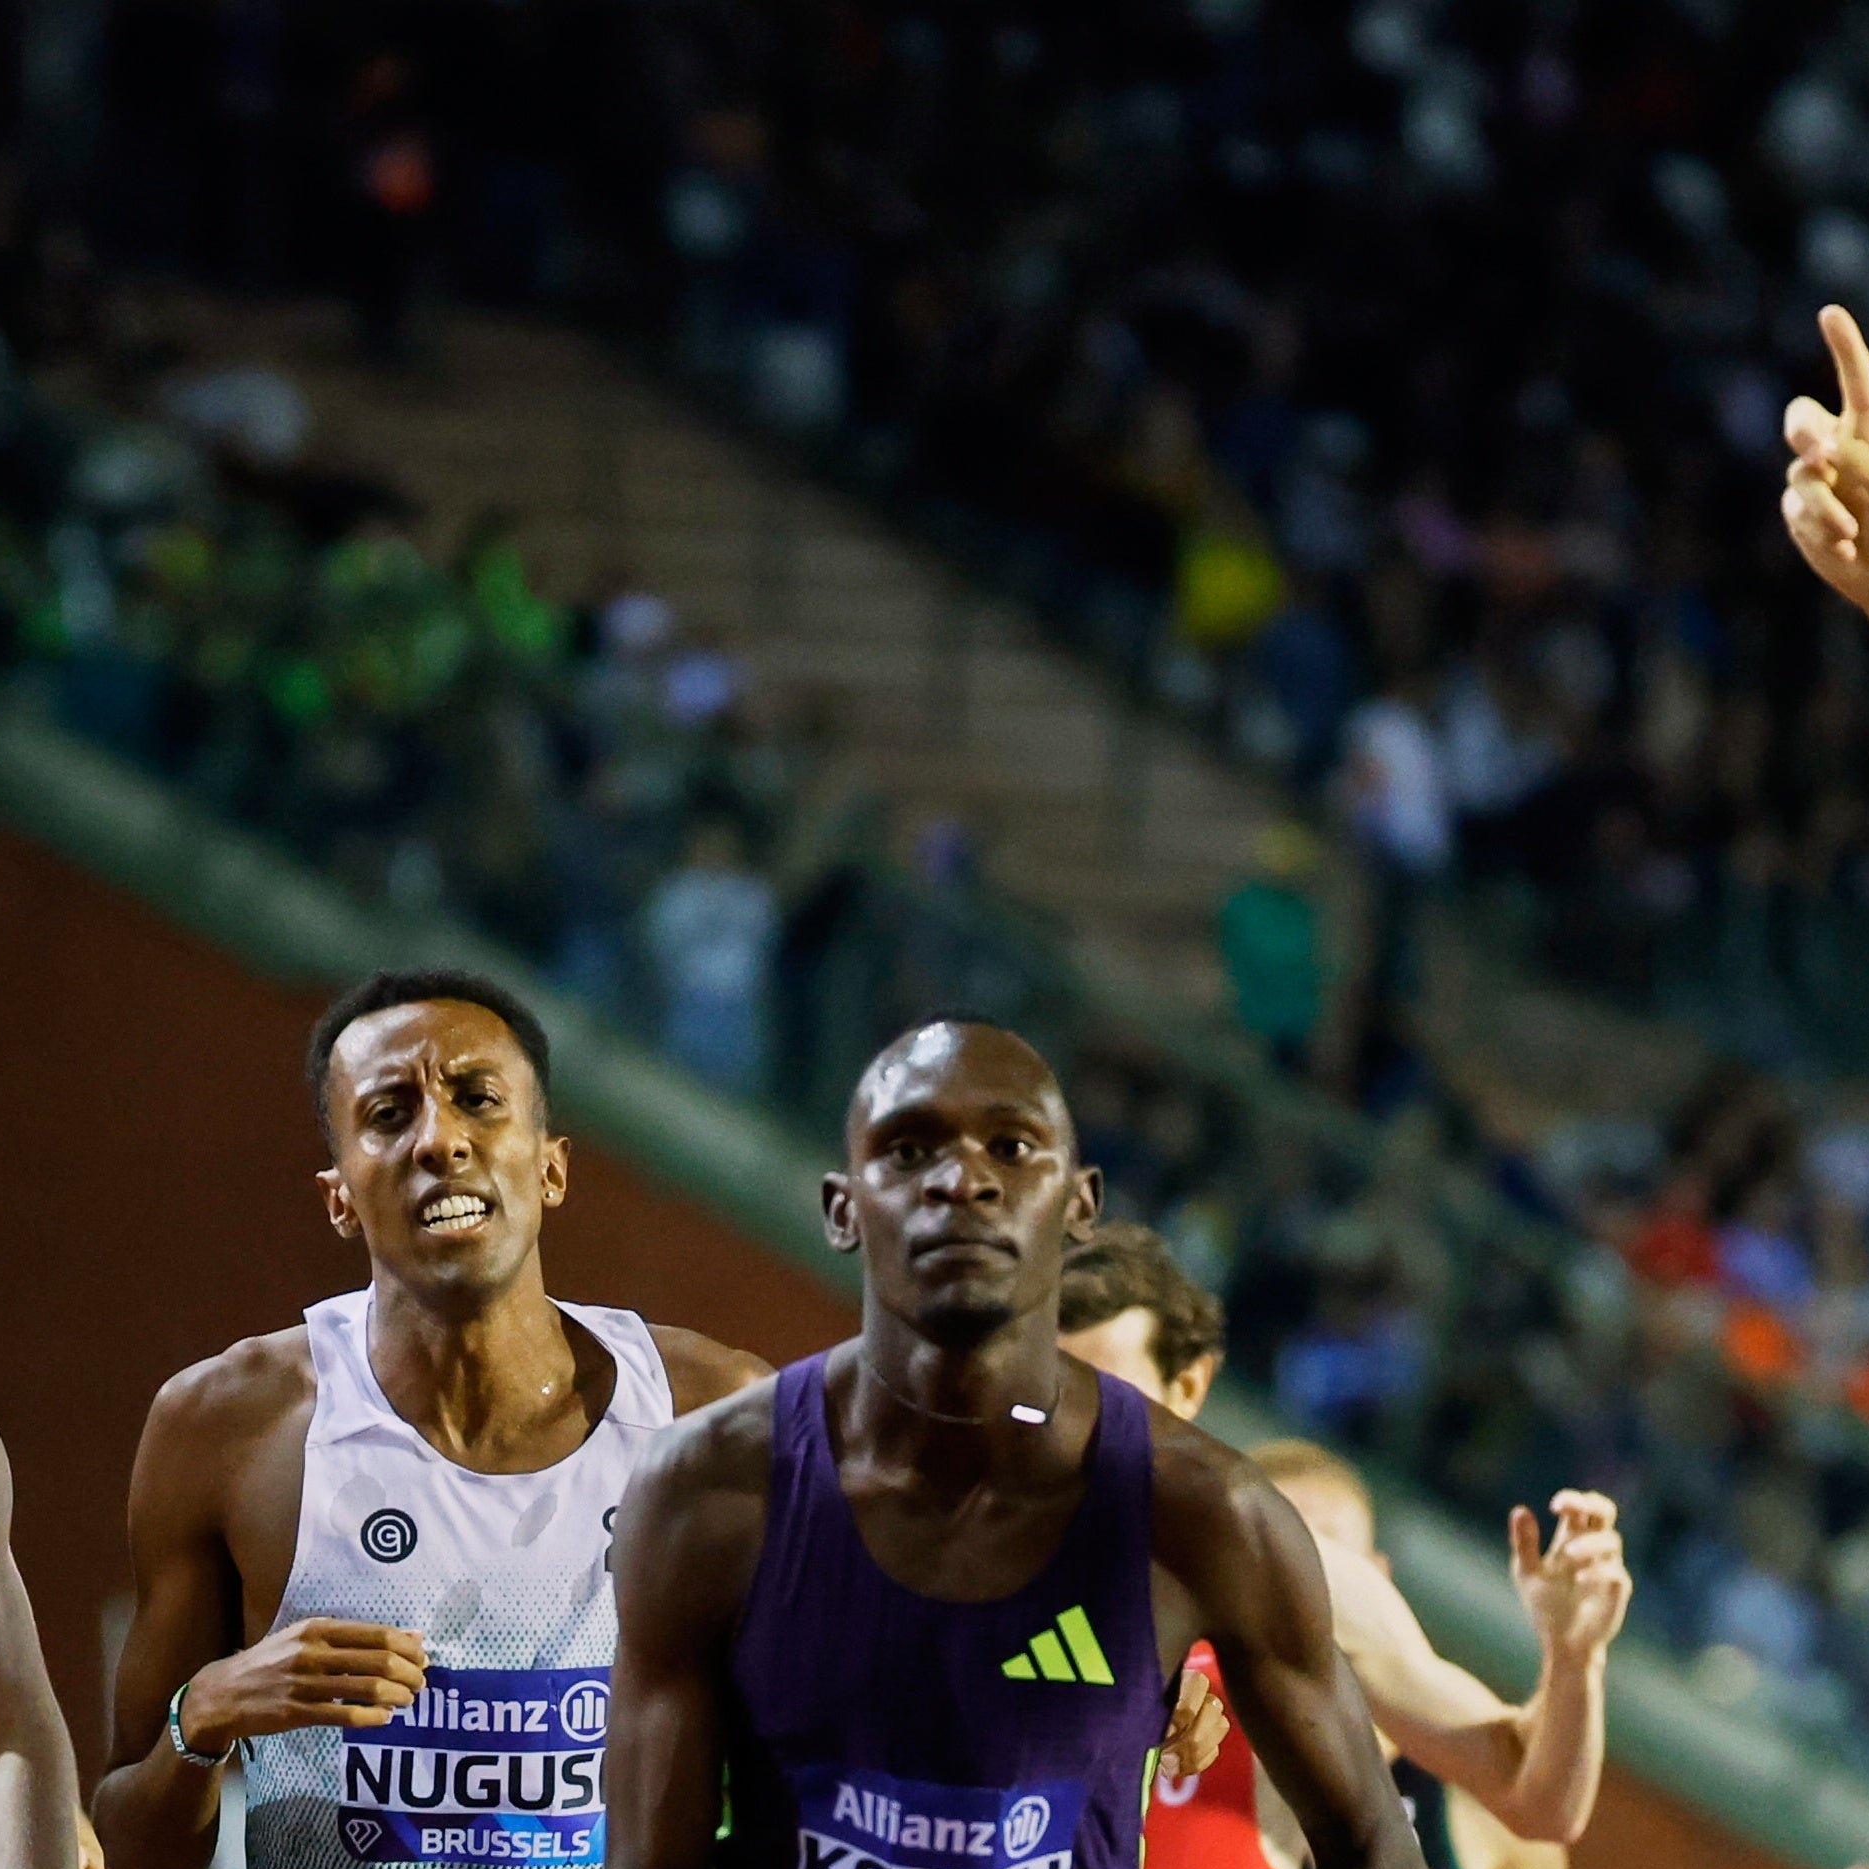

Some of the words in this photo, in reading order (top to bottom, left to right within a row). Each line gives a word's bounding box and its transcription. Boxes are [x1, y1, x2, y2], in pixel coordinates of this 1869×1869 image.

[346, 1746, 606, 1811] NUGUS
[420, 1827, 591, 1859] BRUSSELS
[833, 1782, 996, 1857] Allianz
